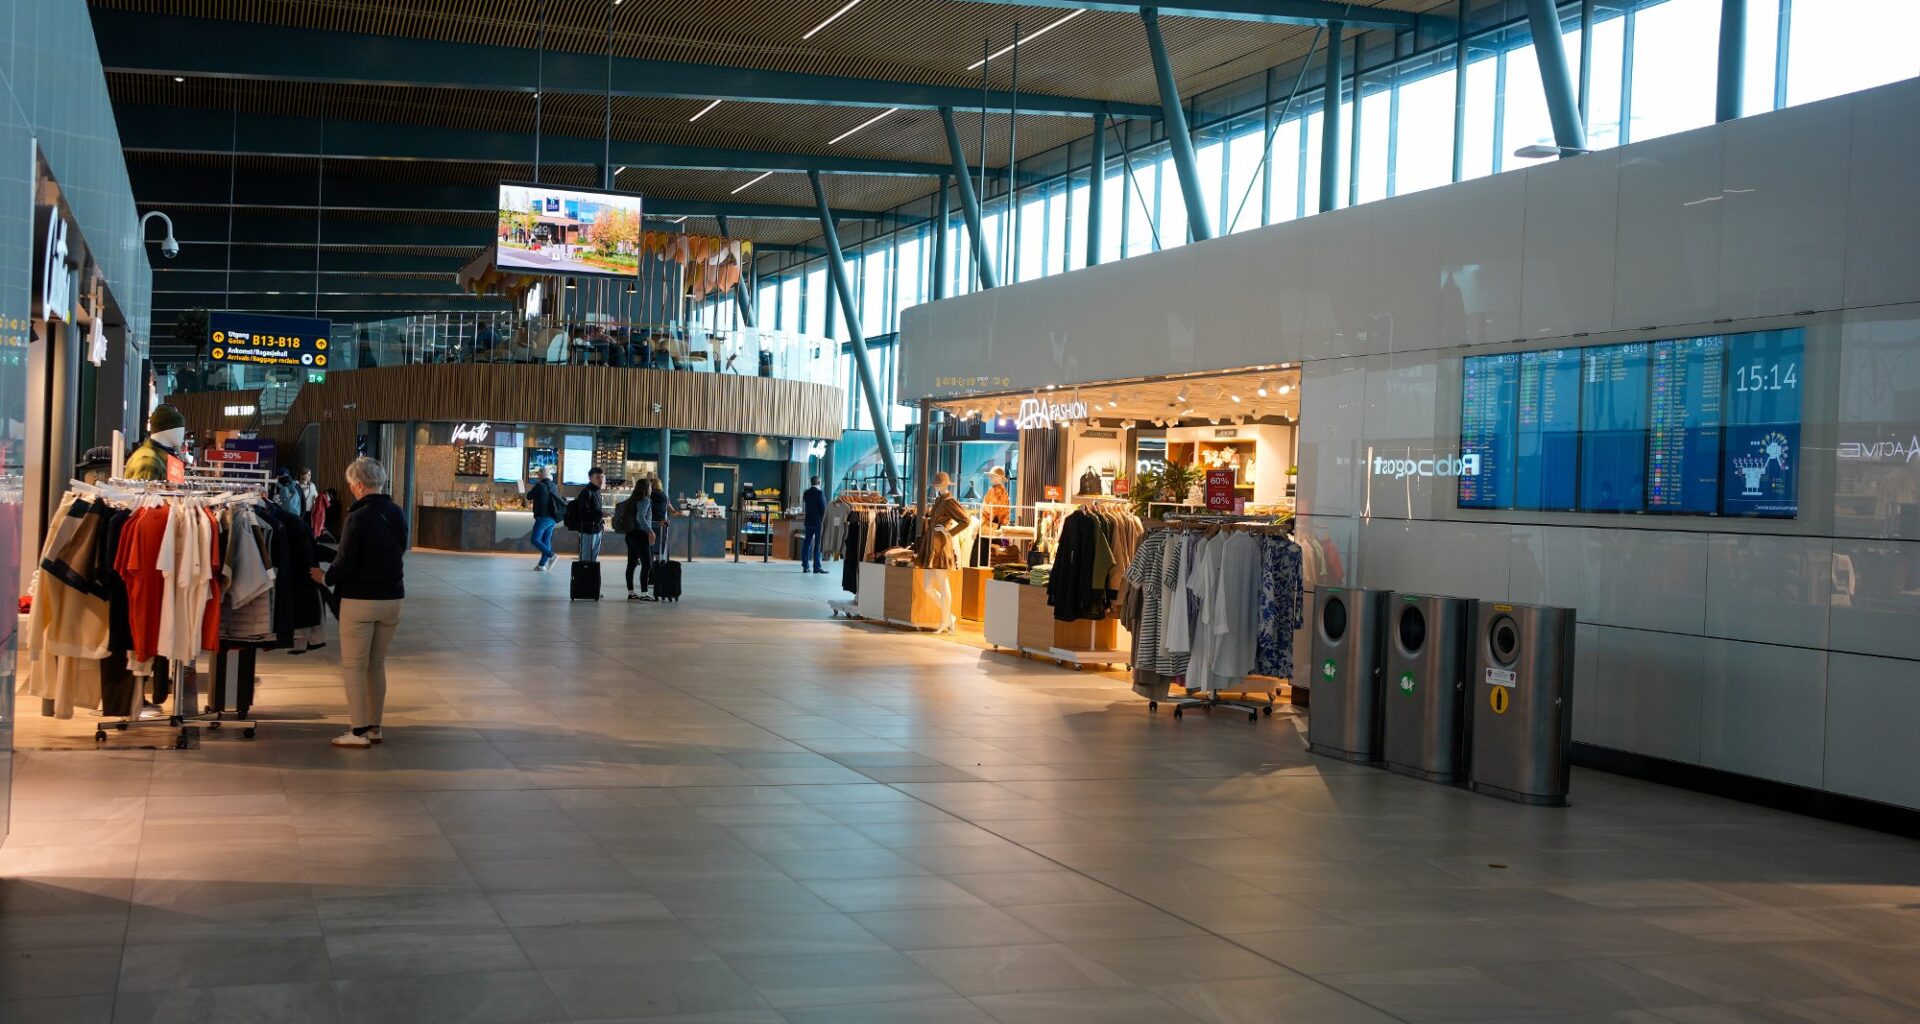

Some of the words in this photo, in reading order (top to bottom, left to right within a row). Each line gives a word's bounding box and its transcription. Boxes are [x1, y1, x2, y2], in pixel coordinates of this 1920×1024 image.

[228, 331, 249, 340] Utgang
[252, 335, 300, 348] B13-B18
[1630, 344, 1648, 353] 15:14
[1737, 363, 1797, 392] 15:14
[1051, 402, 1088, 421] FASHION
[1210, 477, 1230, 485] 60%
[1210, 497, 1230, 505] 60%
